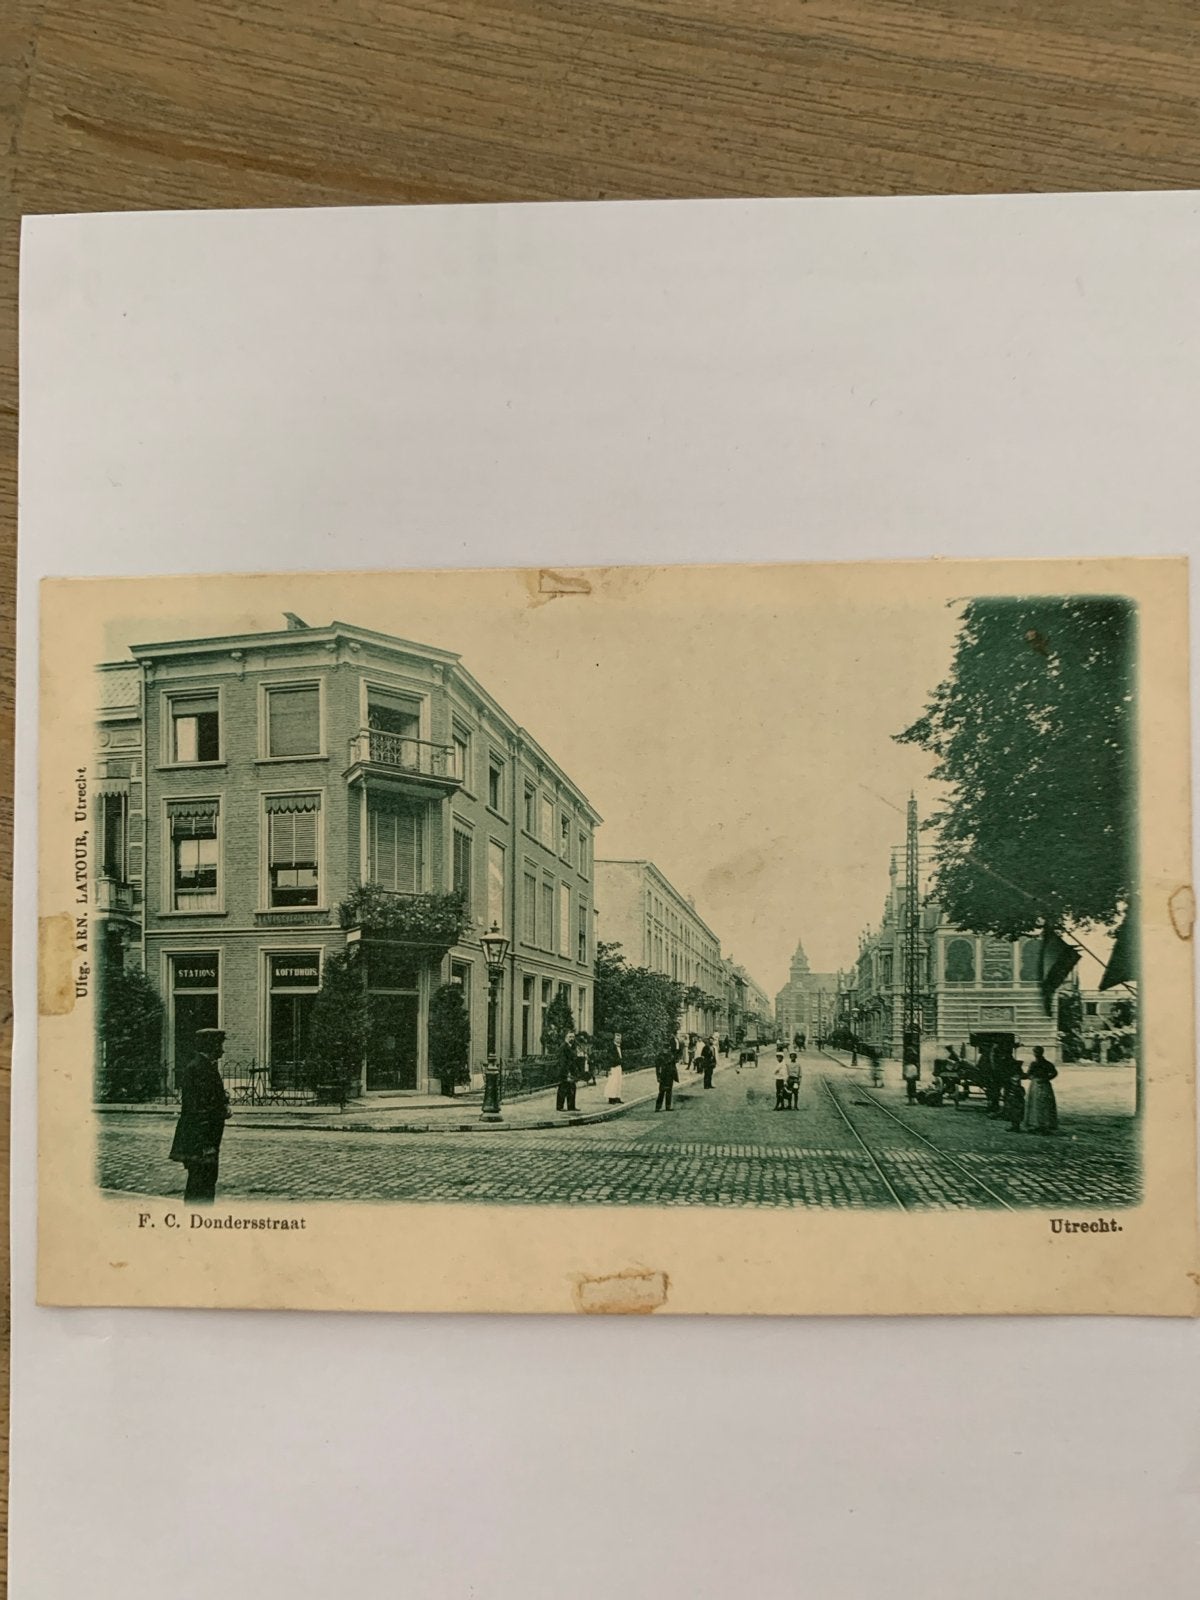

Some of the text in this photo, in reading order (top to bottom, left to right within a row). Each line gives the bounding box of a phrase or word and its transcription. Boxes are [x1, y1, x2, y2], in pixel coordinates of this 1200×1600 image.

[74, 766, 91, 999] Uitg. ARN. LATOUR, Utrecht
[178, 969, 216, 978] STATIONS
[138, 1213, 307, 1230] F. C. Dondersstraat
[1049, 1217, 1123, 1234] Utrecht.
